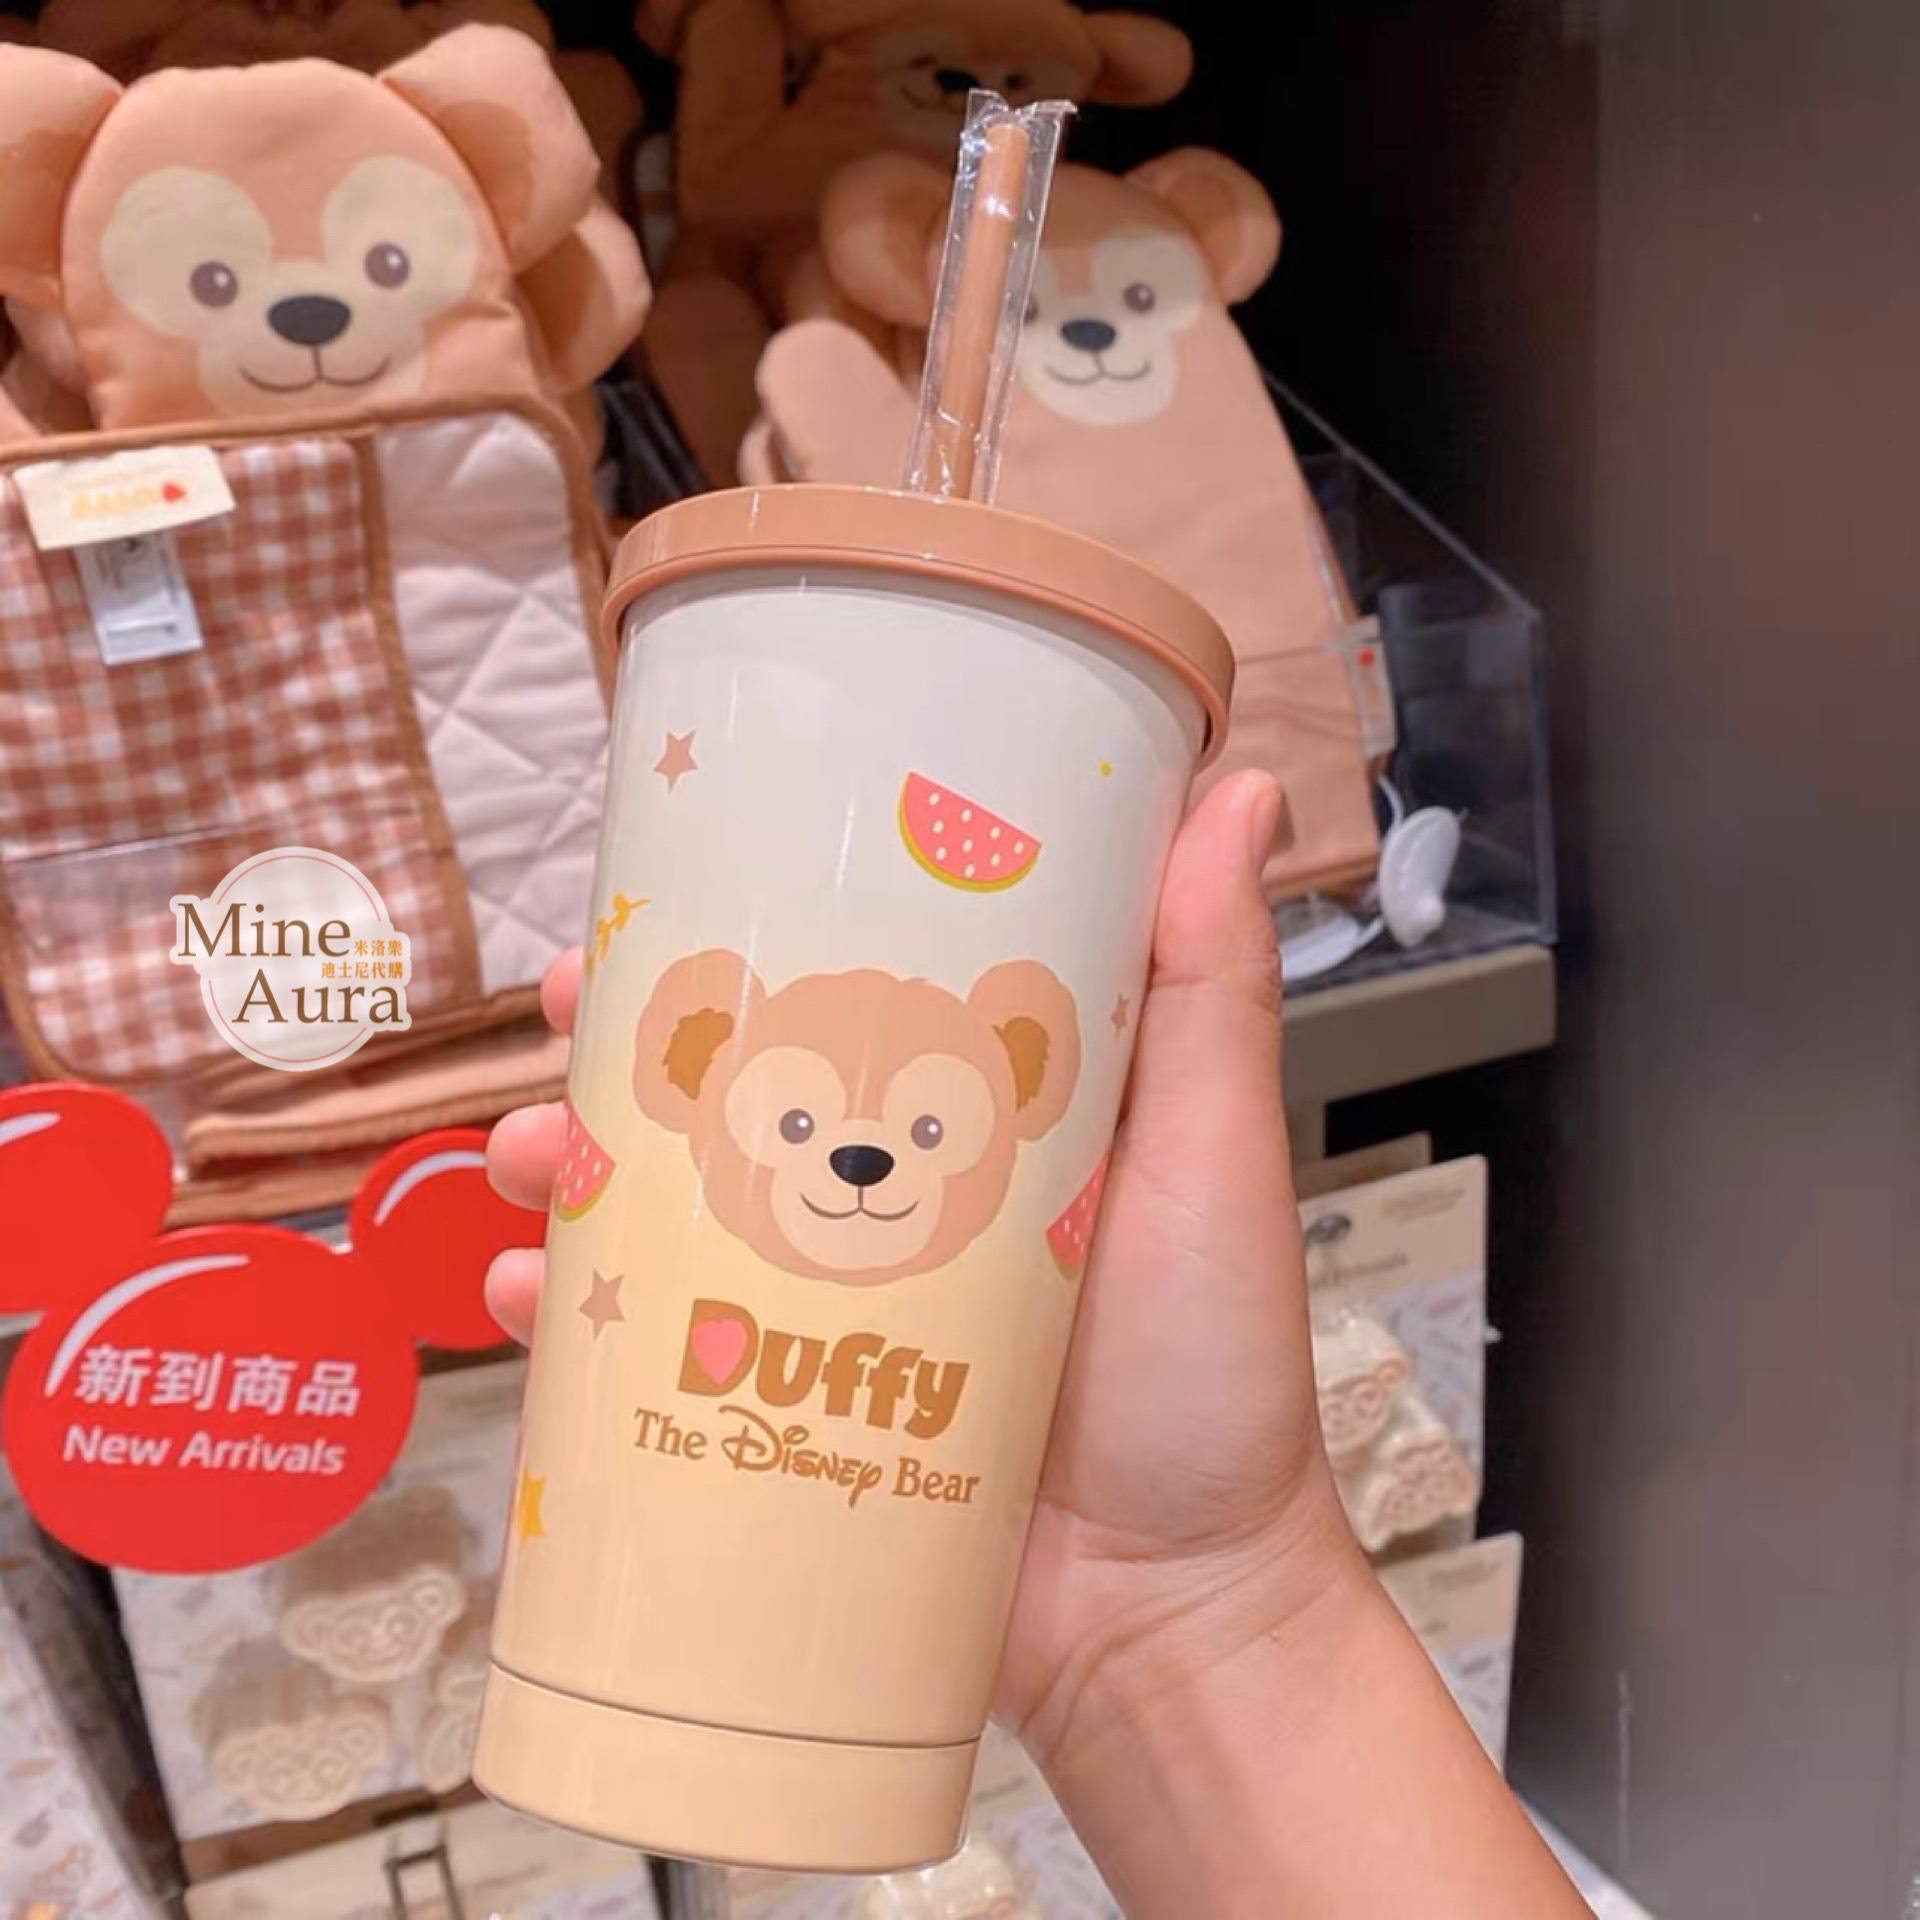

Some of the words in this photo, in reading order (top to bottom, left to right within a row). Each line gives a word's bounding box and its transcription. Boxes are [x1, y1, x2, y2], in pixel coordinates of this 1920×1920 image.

[74, 1343, 360, 1418] 新到商品
[677, 1298, 970, 1440] Duffy
[62, 1424, 171, 1465] New
[178, 1430, 346, 1476] Arrivals
[634, 1407, 707, 1460] The
[718, 1404, 882, 1509] Disney
[892, 1456, 981, 1504] Bear
